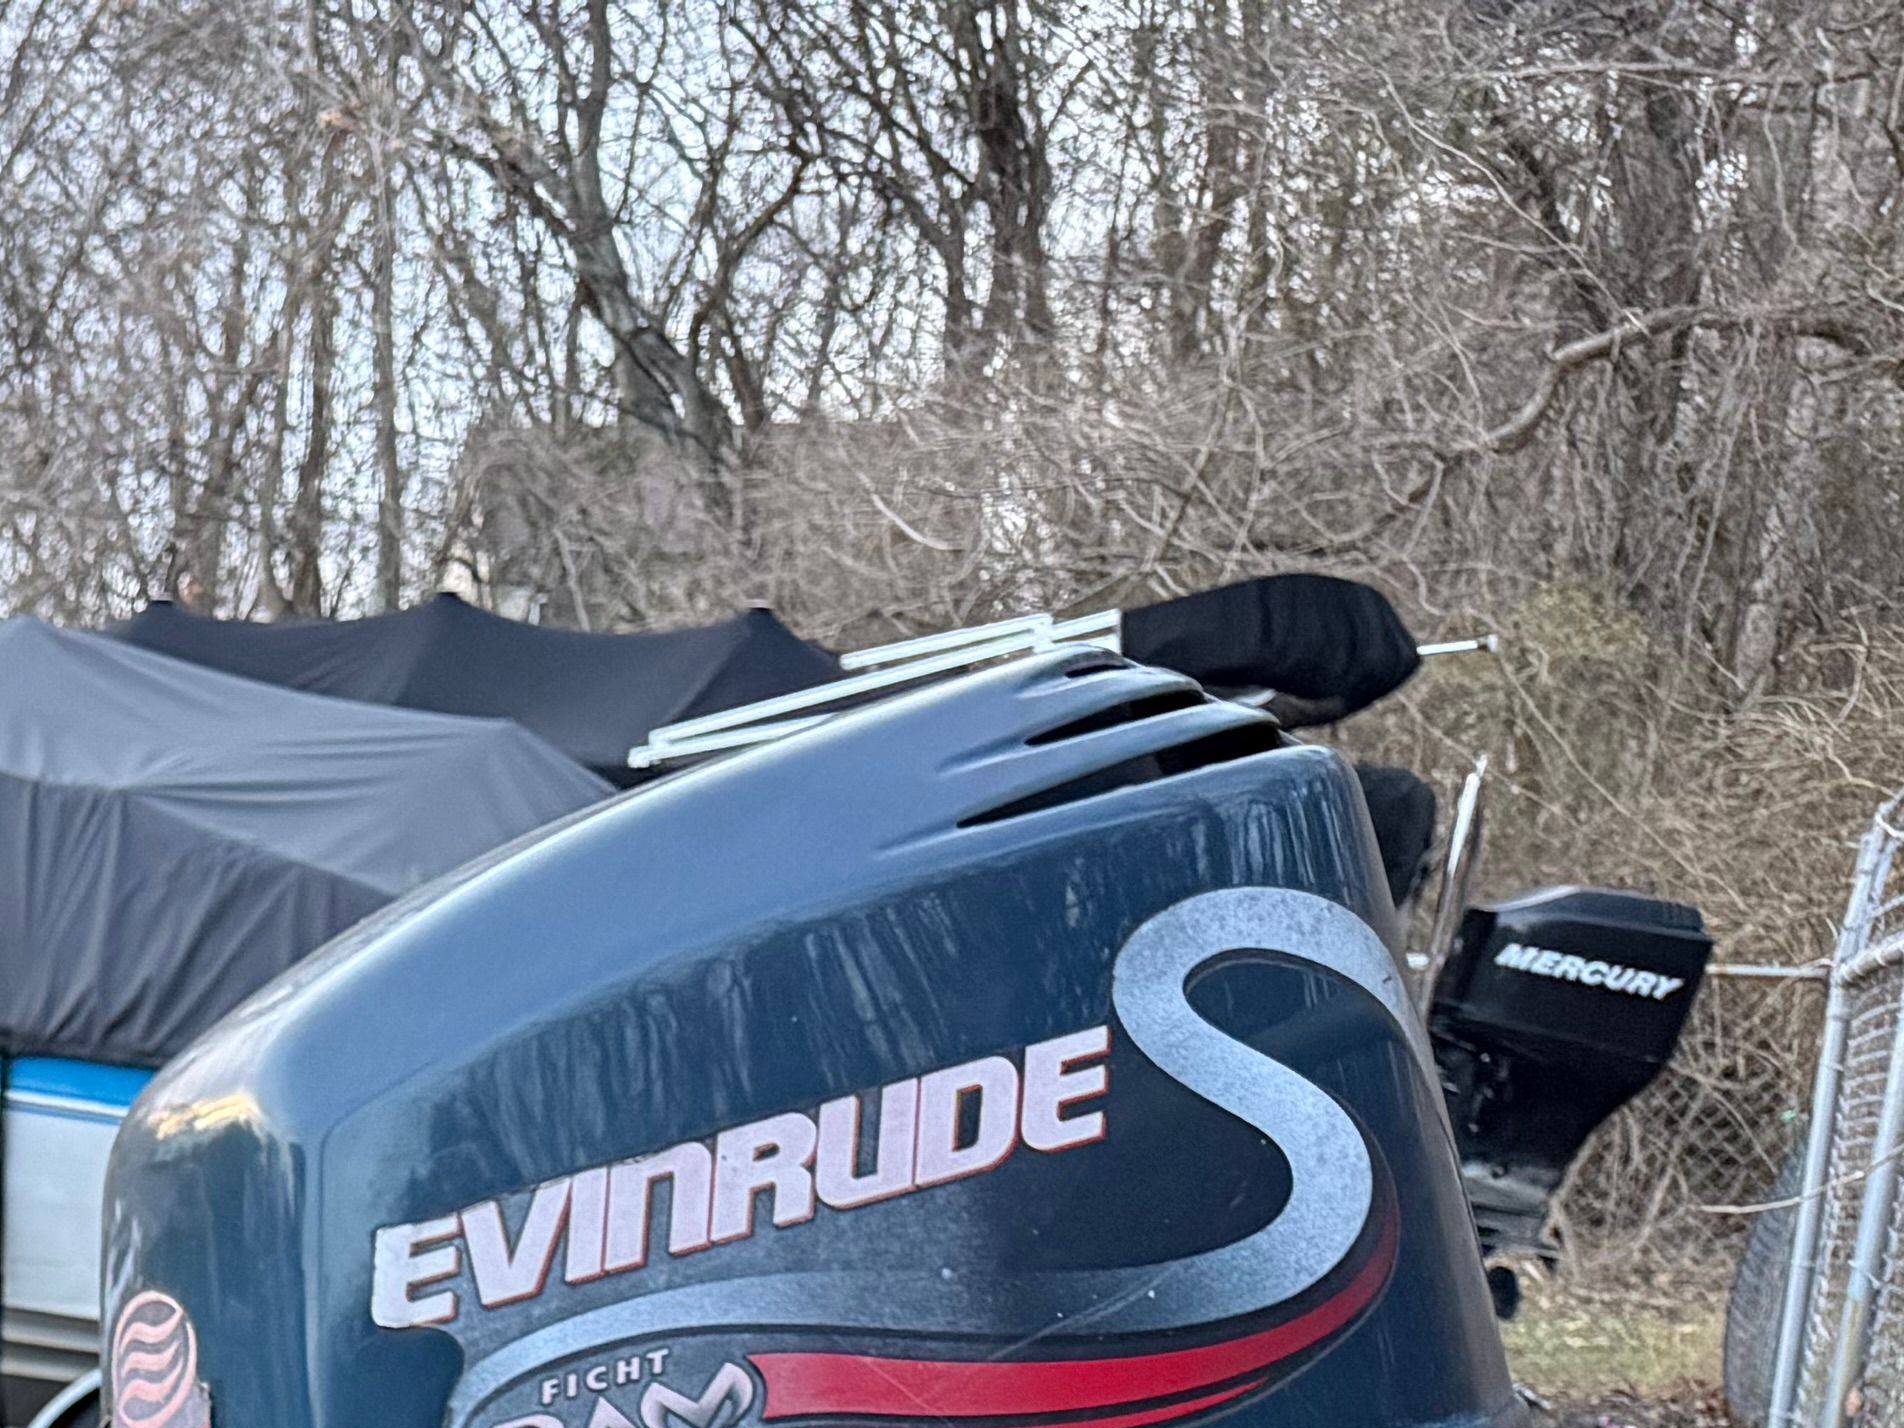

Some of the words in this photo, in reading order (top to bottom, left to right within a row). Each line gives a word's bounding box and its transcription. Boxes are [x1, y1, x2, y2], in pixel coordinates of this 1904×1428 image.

[1495, 943, 1685, 1000] MERCURY
[371, 1024, 1113, 1328] EVINRUDE
[542, 1347, 669, 1406] FICHT
